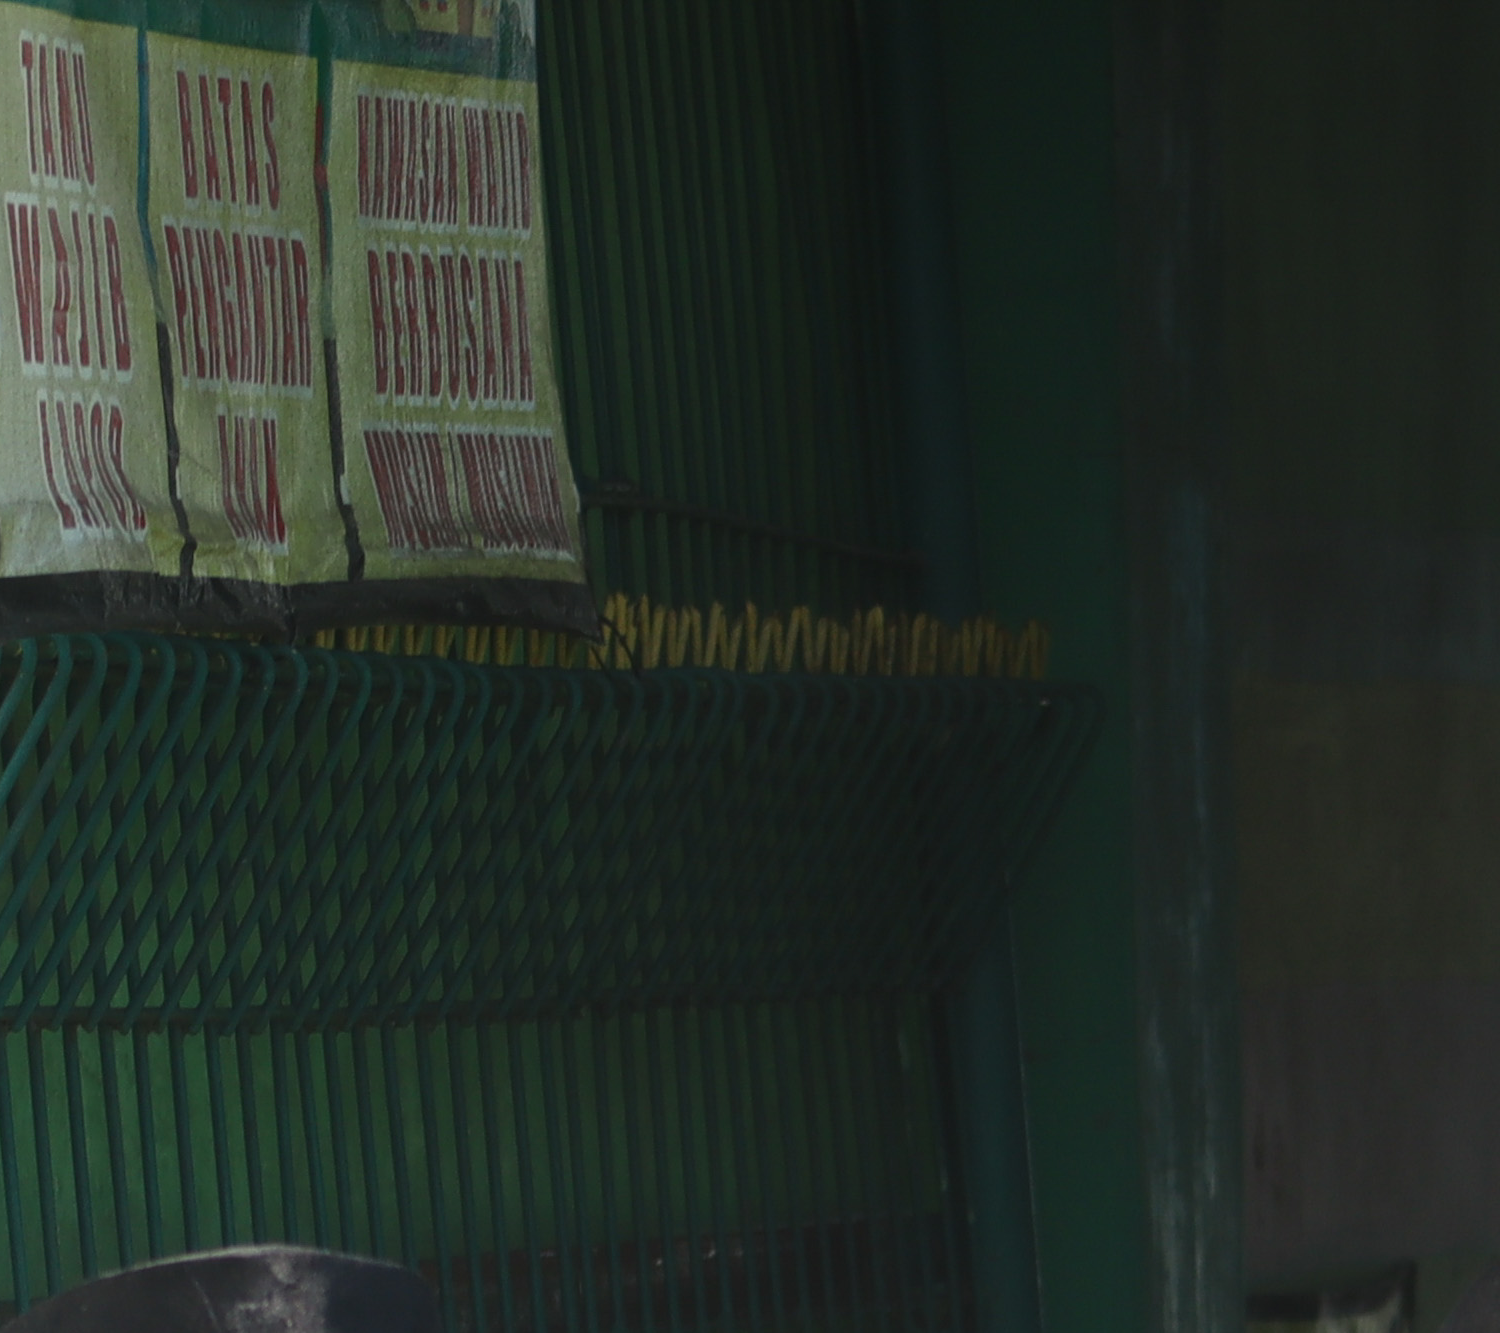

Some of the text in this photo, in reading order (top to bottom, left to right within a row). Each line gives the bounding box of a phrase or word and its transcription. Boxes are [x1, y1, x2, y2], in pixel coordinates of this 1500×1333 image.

[20, 39, 96, 188] TAMU
[176, 70, 282, 211] BATAS
[356, 94, 532, 232] KAWASAN WAJIB
[6, 202, 132, 374] WAJIB
[164, 224, 313, 388] PENGANTAR
[366, 249, 534, 402] BERBUSANA
[38, 400, 147, 532] LAPOR
